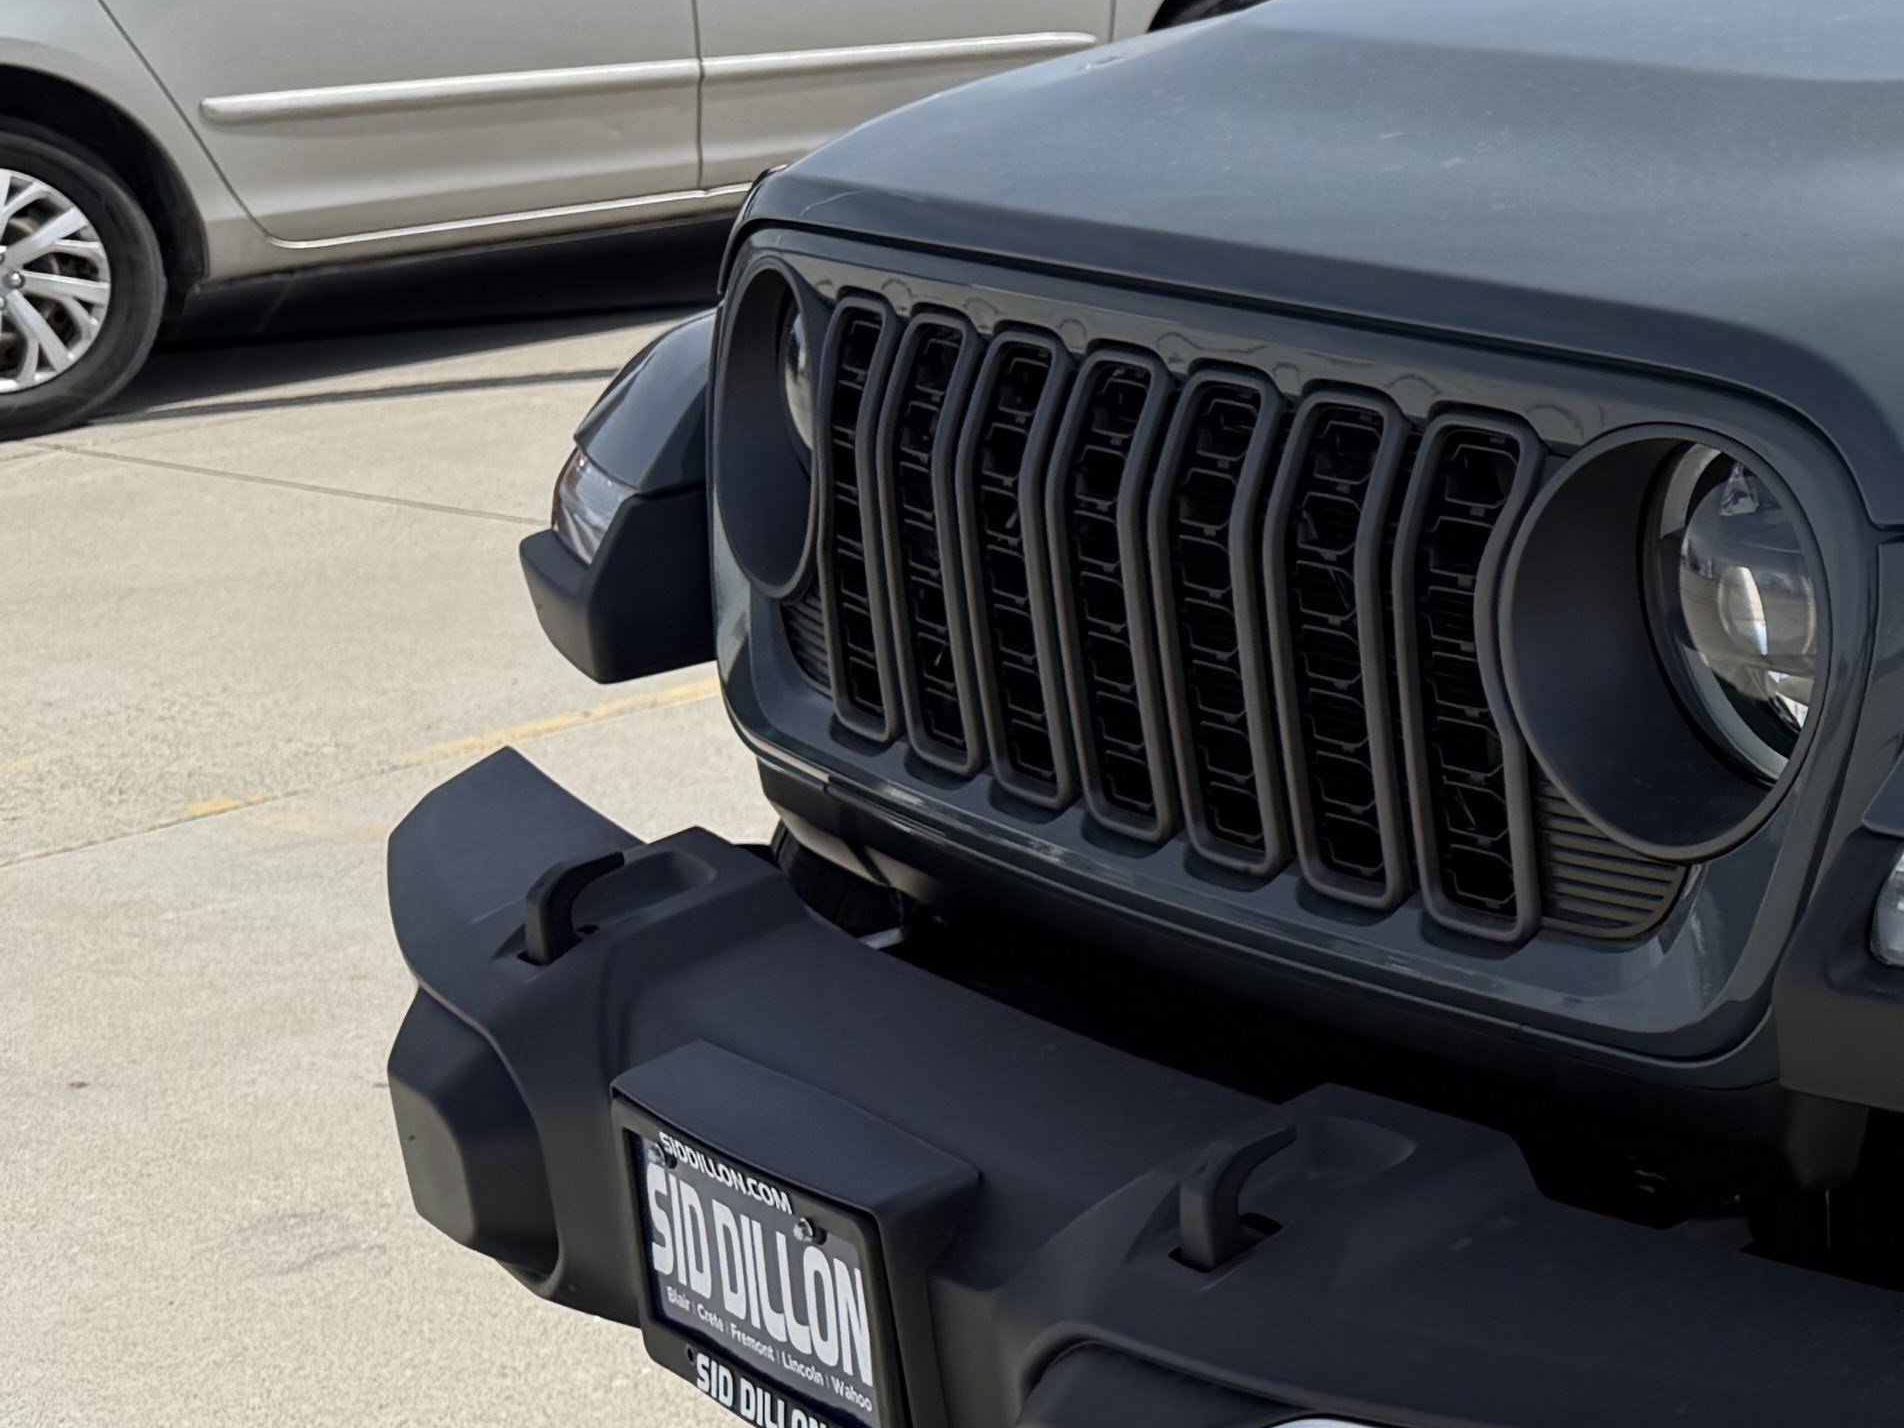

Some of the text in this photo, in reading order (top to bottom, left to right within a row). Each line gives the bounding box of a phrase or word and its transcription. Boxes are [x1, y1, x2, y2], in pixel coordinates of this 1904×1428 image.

[658, 1130, 794, 1216] SIDDILLON.COM
[645, 1161, 874, 1388] SID DILLON
[666, 1285, 873, 1414] Blair Crete Fremont Lincoln Wahoo
[695, 1352, 734, 1409] SID
